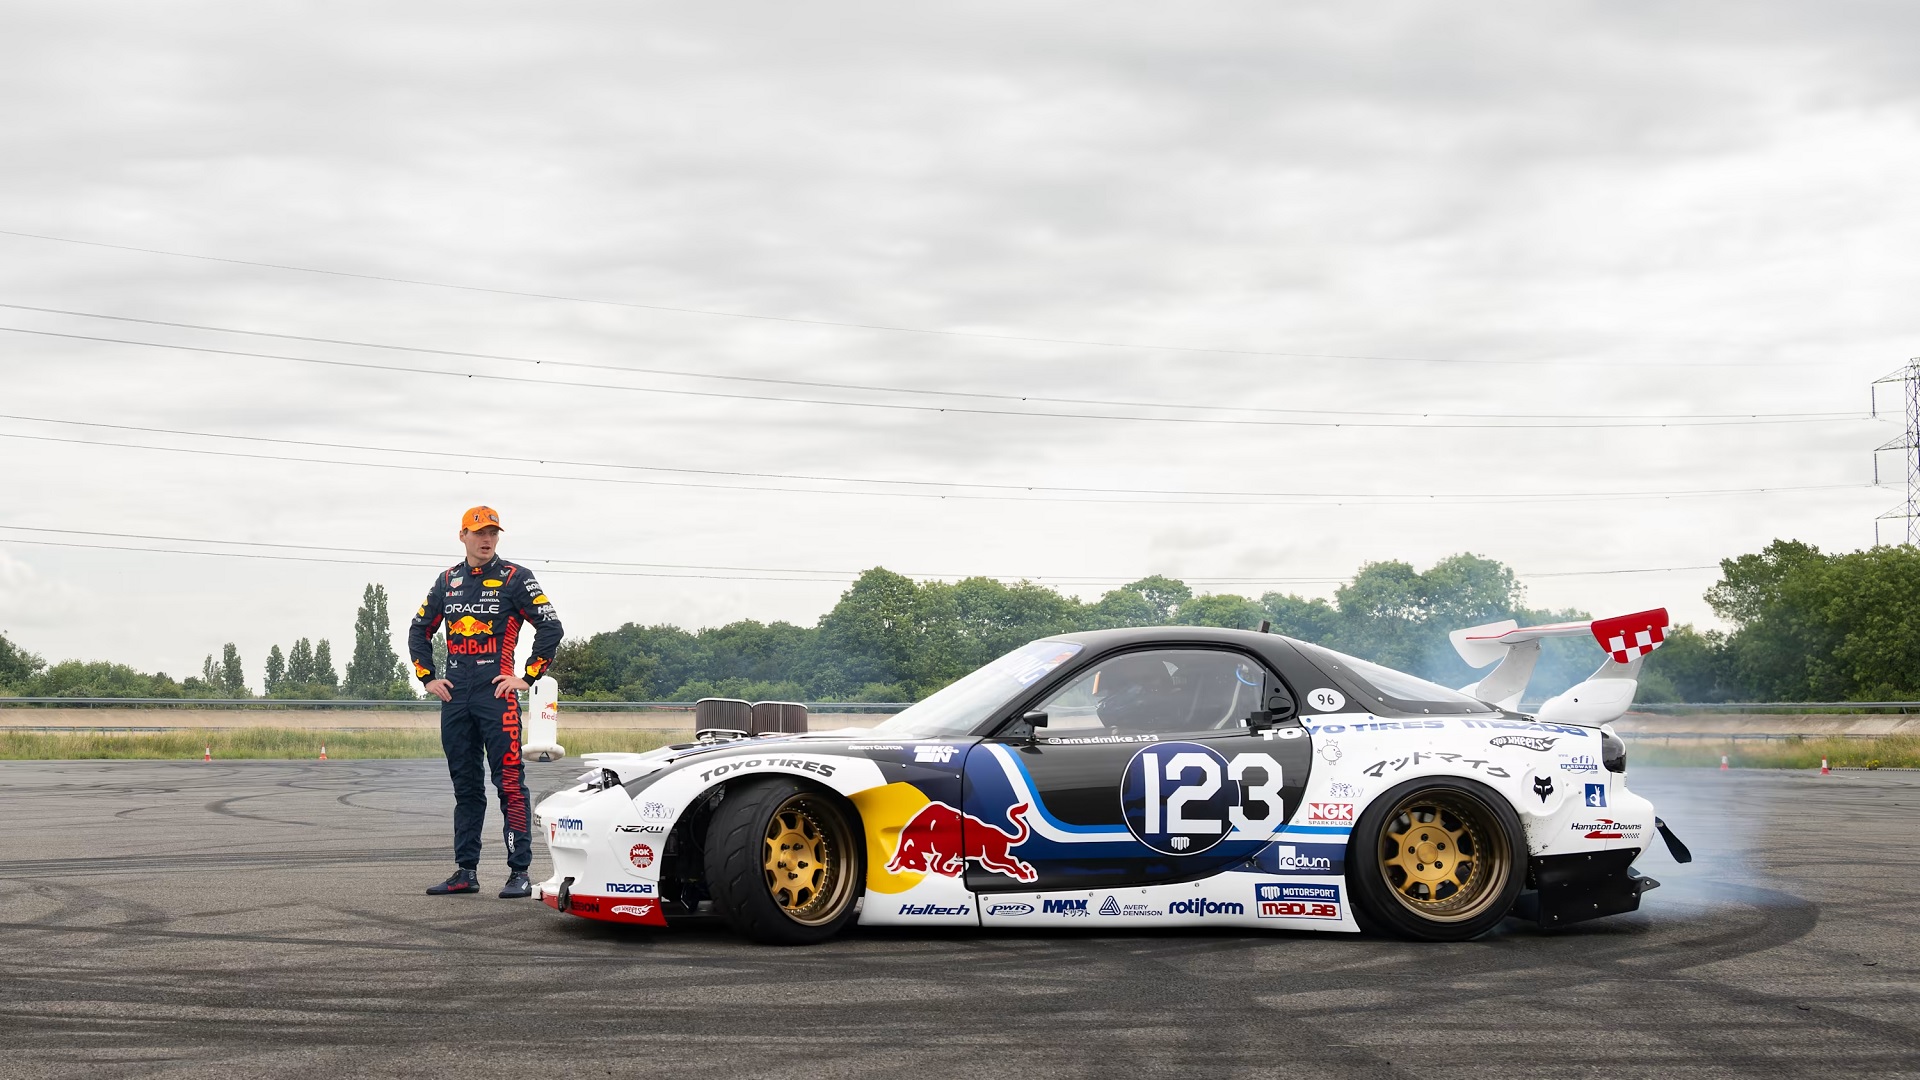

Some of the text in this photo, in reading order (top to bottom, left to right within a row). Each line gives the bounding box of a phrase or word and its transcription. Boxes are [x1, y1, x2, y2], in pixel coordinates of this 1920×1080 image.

[481, 589, 500, 597] BYBIT
[444, 603, 500, 614] ORACLE
[1317, 693, 1335, 706] 96
[1257, 720, 1445, 741] TOYO TIRES
[1363, 752, 1511, 778] マッドマイク
[1571, 755, 1589, 763] efi
[700, 758, 836, 782] TOYO TIRES
[1143, 753, 1284, 835] 123
[1309, 804, 1352, 820] NGK
[1571, 822, 1642, 832] Hampton Downs
[1280, 854, 1331, 868] radium
[1283, 887, 1336, 898] MOTORSPORT
[898, 904, 971, 916] Haltech
[1042, 899, 1089, 914] MAX
[1169, 898, 1244, 917] rotiform
